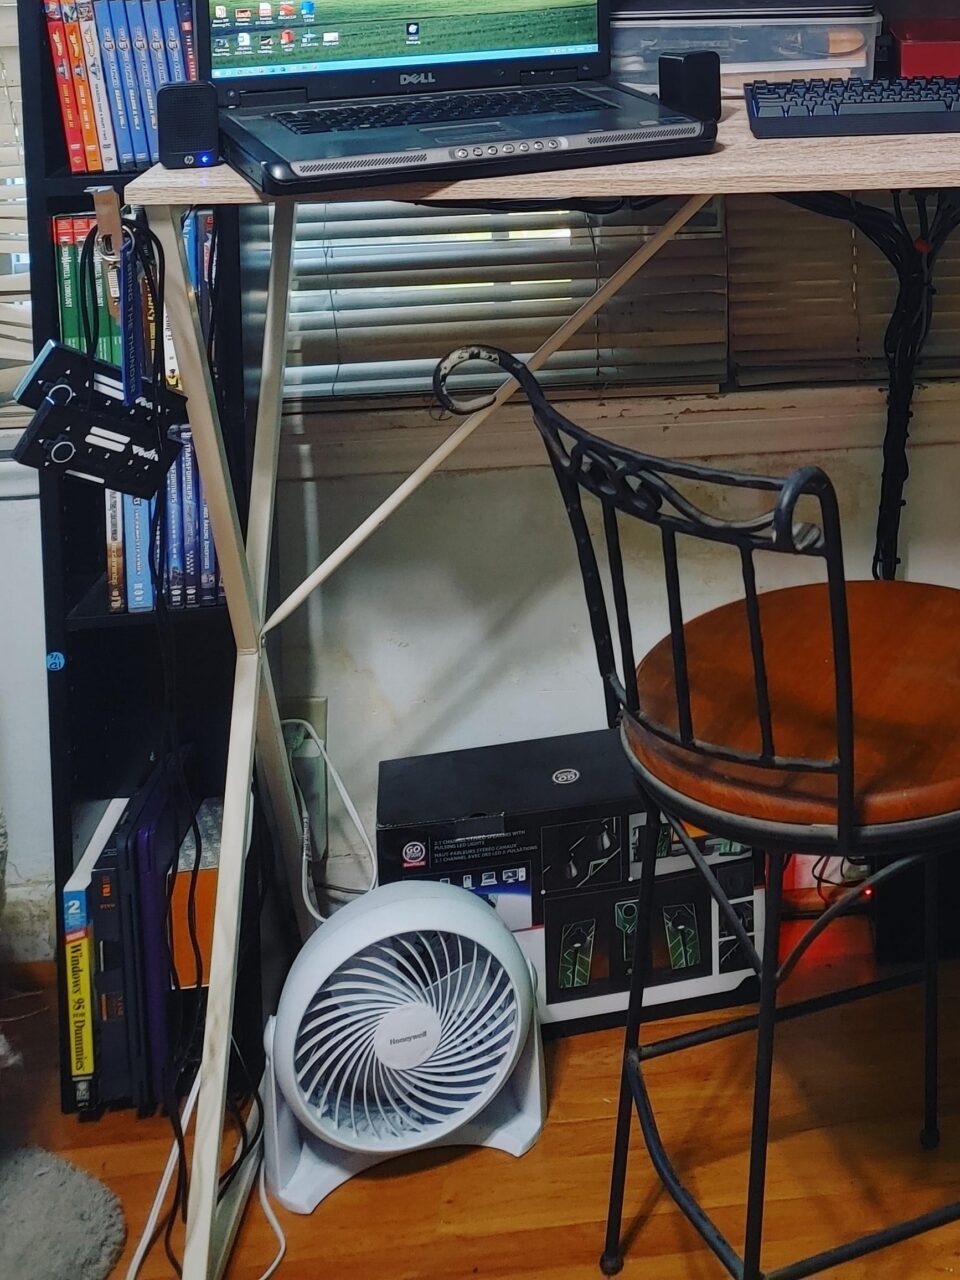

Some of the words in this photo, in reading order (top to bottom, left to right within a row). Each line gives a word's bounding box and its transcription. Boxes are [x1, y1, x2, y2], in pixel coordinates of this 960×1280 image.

[400, 72, 436, 85] DELL
[65, 279, 73, 308] TECHNOLOGY
[128, 334, 136, 393] THUNDER
[184, 443, 193, 501] TRANSFORMERS
[406, 844, 421, 854] GO
[68, 899, 81, 914] 2
[70, 942, 83, 995] Windows
[73, 997, 85, 1010] 95
[74, 1019, 86, 1072] Dummies
[389, 1030, 427, 1045] Honeywell
